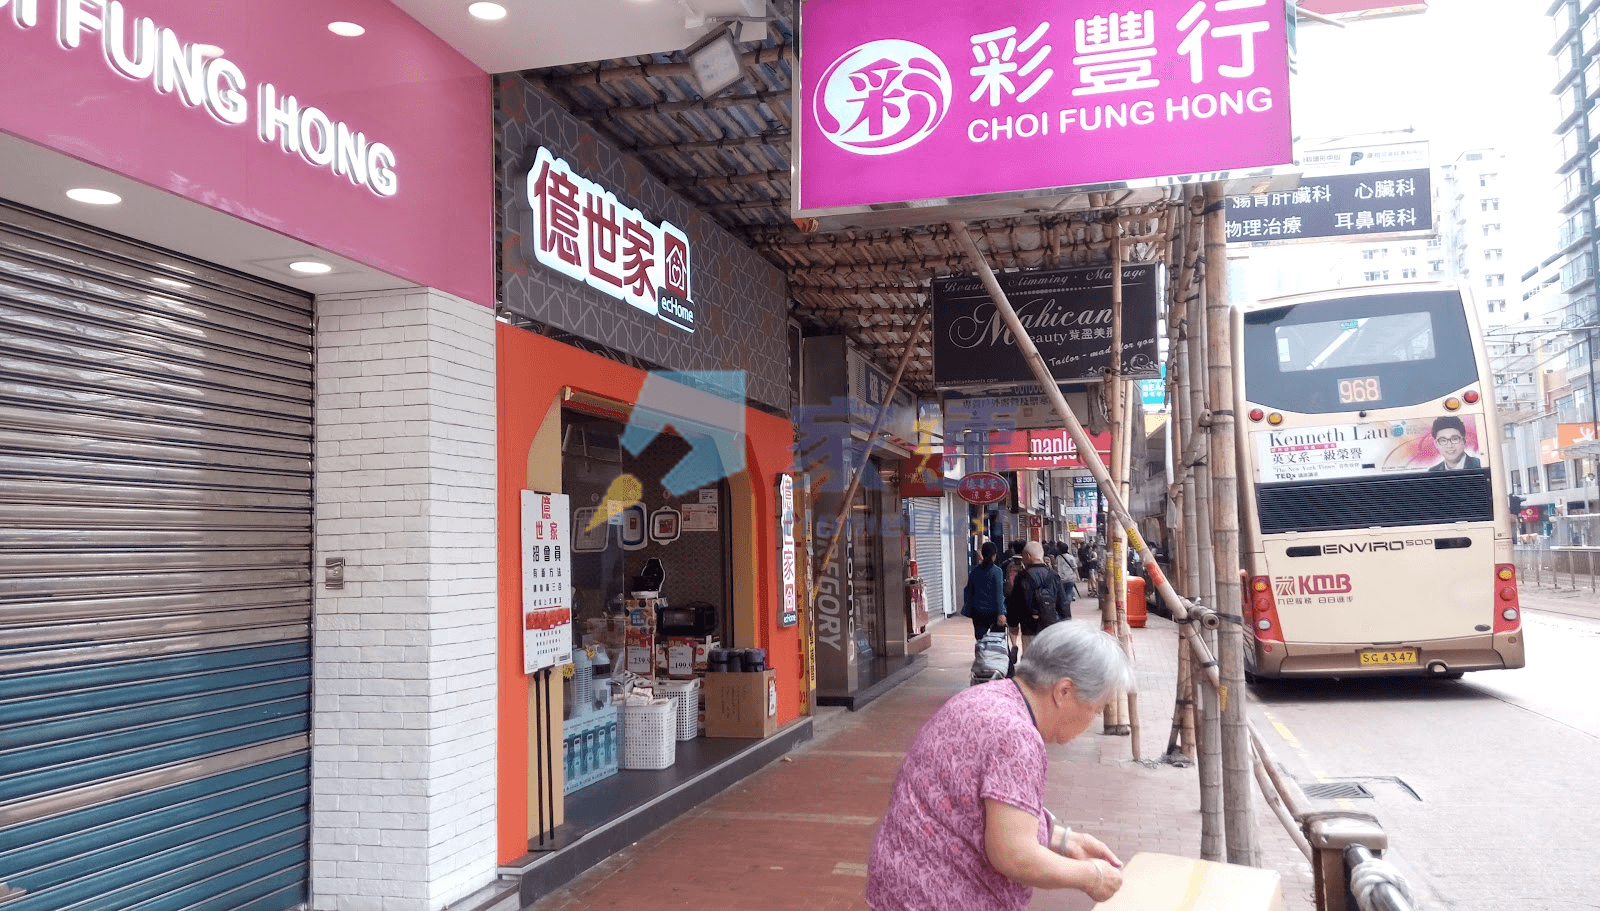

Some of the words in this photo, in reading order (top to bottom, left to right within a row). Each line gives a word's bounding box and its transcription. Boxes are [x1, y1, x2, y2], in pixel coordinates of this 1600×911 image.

[968, 0, 1271, 107] 彩豐行
[57, 0, 248, 125] FUNG
[258, 82, 398, 197] HONG
[967, 112, 1050, 143] CHOI
[1060, 100, 1155, 134] FUNG
[1166, 87, 1273, 122] HONG
[1354, 177, 1415, 199] 心臟科
[533, 159, 657, 302] 億世家
[1225, 216, 1302, 238] 物理治療
[1334, 208, 1417, 230] 耳鼻喉科
[1086, 267, 1146, 280] Maage
[661, 296, 694, 324] ecHome
[1029, 331, 1067, 346] eauty
[1089, 346, 1113, 358] mad
[1338, 377, 1380, 402] 968
[1029, 431, 1078, 465] maple
[1269, 427, 1345, 447] Kenneth
[1353, 426, 1388, 441] Lau
[1273, 447, 1363, 465] 英文系一級榮譽
[1322, 541, 1405, 555] ENVIRO
[1405, 538, 1433, 547] 500
[1298, 573, 1353, 596] KMB
[1362, 653, 1379, 663] SG
[1382, 651, 1414, 662] 4347
